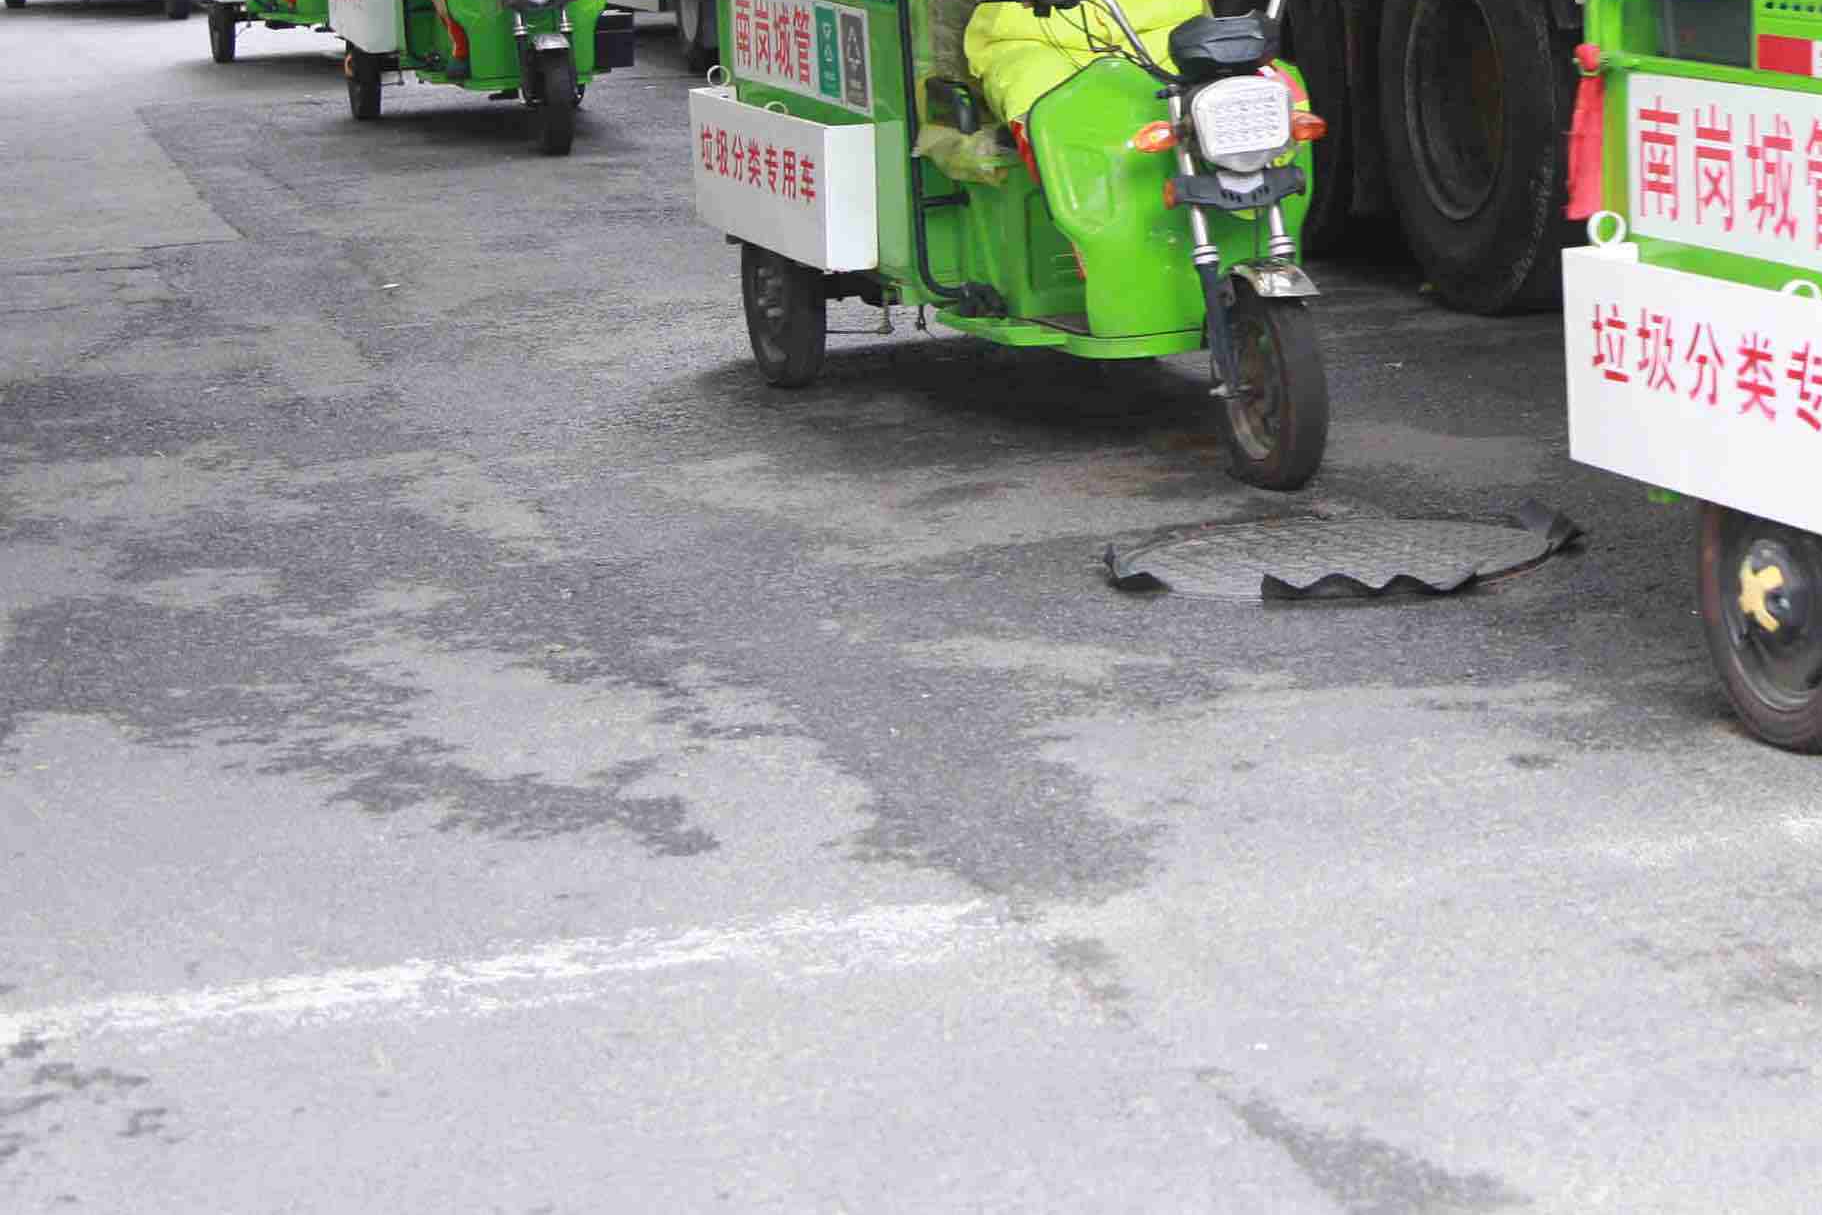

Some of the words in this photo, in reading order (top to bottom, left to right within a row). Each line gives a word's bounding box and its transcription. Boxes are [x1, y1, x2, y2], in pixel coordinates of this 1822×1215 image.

[700, 122, 816, 205] 垃圾分类专用车
